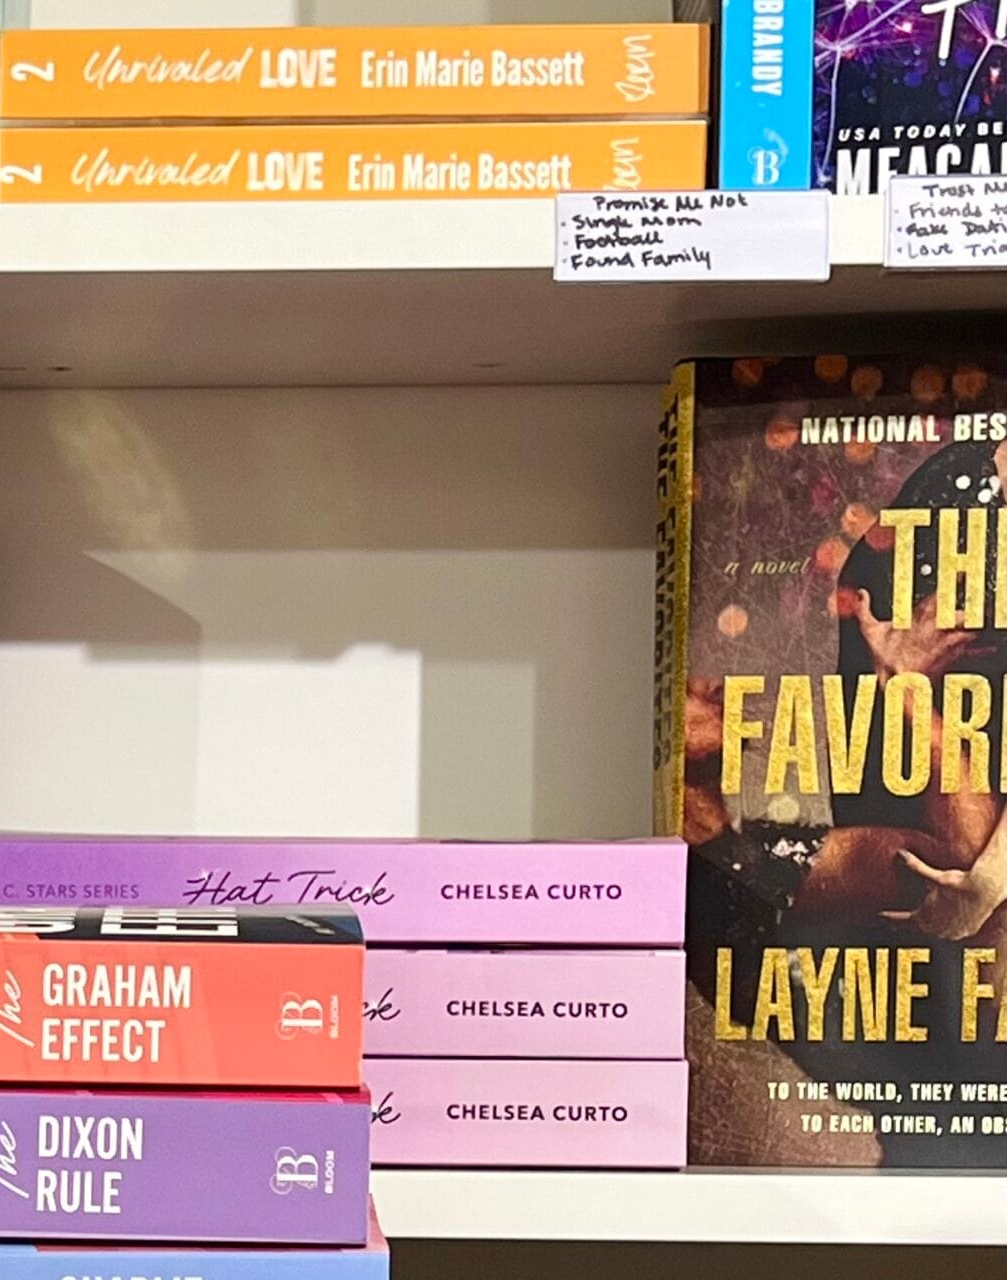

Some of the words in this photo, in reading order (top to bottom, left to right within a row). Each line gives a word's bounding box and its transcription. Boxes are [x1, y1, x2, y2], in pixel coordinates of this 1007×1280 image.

[752, 0, 783, 96] BRANDY
[84, 44, 253, 90] Unrivaled
[260, 48, 336, 88] LOVE
[361, 52, 406, 88] Erin
[416, 51, 485, 87] Marie
[492, 51, 585, 87] Bassett
[839, 127, 880, 142] USA
[894, 123, 966, 140] TODAY
[71, 148, 238, 188] Unrivaled
[247, 152, 324, 190] LOVE
[348, 153, 394, 190] Erin
[403, 153, 472, 189] Marie
[479, 153, 572, 189] Bassett
[922, 182, 974, 198] Trust
[594, 195, 668, 212] Promise
[676, 197, 702, 212] Me
[711, 193, 748, 210] Not
[909, 202, 982, 219] Friends
[572, 214, 632, 236] Single
[575, 231, 663, 250] Football
[908, 241, 953, 259] Love
[572, 254, 634, 270] Found
[644, 247, 711, 270] Family
[802, 414, 940, 445] NATIONAL
[724, 560, 739, 574] a
[752, 557, 811, 575] novel
[27, 884, 79, 899] STARS
[83, 884, 139, 899] SERIES
[182, 870, 280, 906] Hat
[287, 870, 394, 906] Trick
[441, 884, 539, 900] CHELSEA
[547, 884, 622, 900] CURTO
[43, 963, 191, 1009] GRAHAM
[715, 947, 931, 1042] LAYNE
[447, 1001, 544, 1016] CHELSEA
[553, 1002, 628, 1018] CURTO
[41, 1018, 166, 1063] EFFECT
[768, 1082, 789, 1100] TO
[797, 1082, 829, 1100] THE
[836, 1082, 903, 1103] WORLD,
[910, 1083, 953, 1101] THEY
[961, 1083, 1007, 1102] WERE
[447, 1104, 544, 1120] CHELSEA
[553, 1105, 628, 1122] CURTO
[801, 1114, 822, 1133] TO
[830, 1115, 873, 1133] EACH
[880, 1115, 943, 1136] OTHER,
[950, 1116, 974, 1134] AN
[39, 1115, 143, 1161] DIXON
[37, 1170, 122, 1214] RULE
